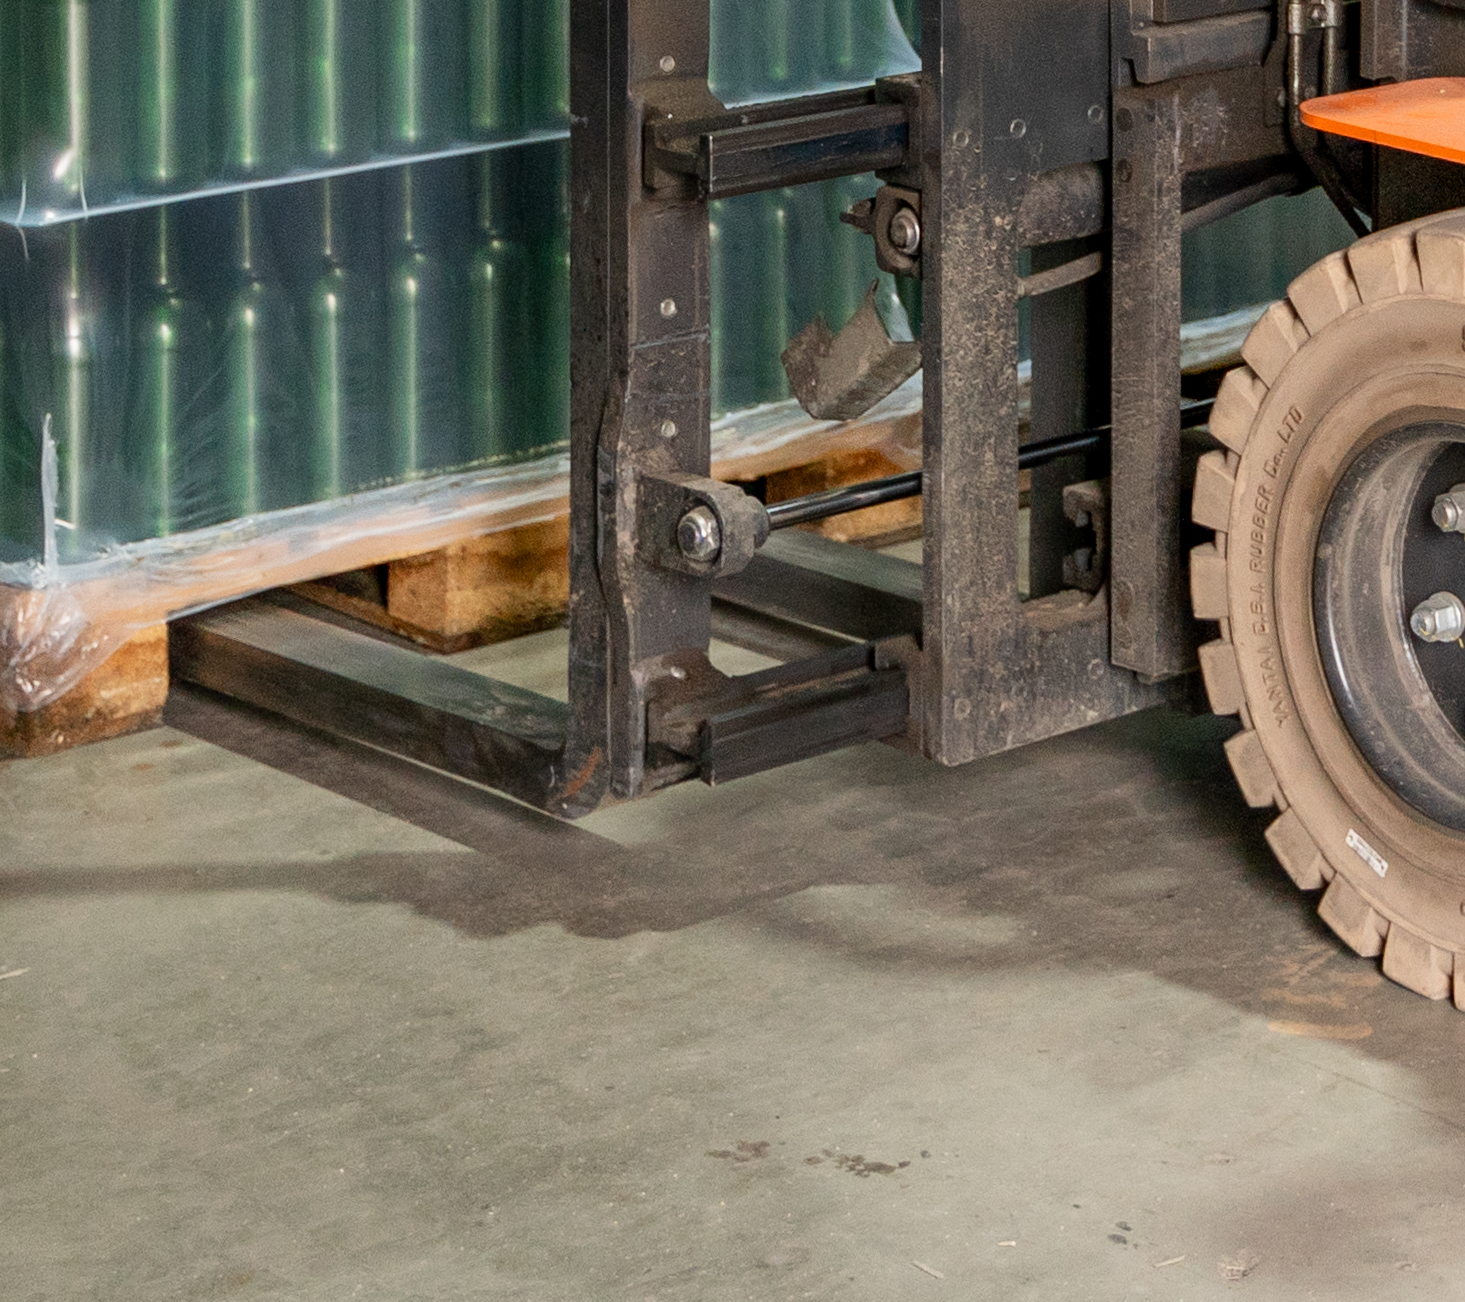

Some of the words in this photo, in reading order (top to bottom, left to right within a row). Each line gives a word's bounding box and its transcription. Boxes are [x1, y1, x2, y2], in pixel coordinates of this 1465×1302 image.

[1277, 402, 1304, 443] LTD
[1248, 485, 1272, 574] RUBBER
[1256, 646, 1292, 729] YANTAI
